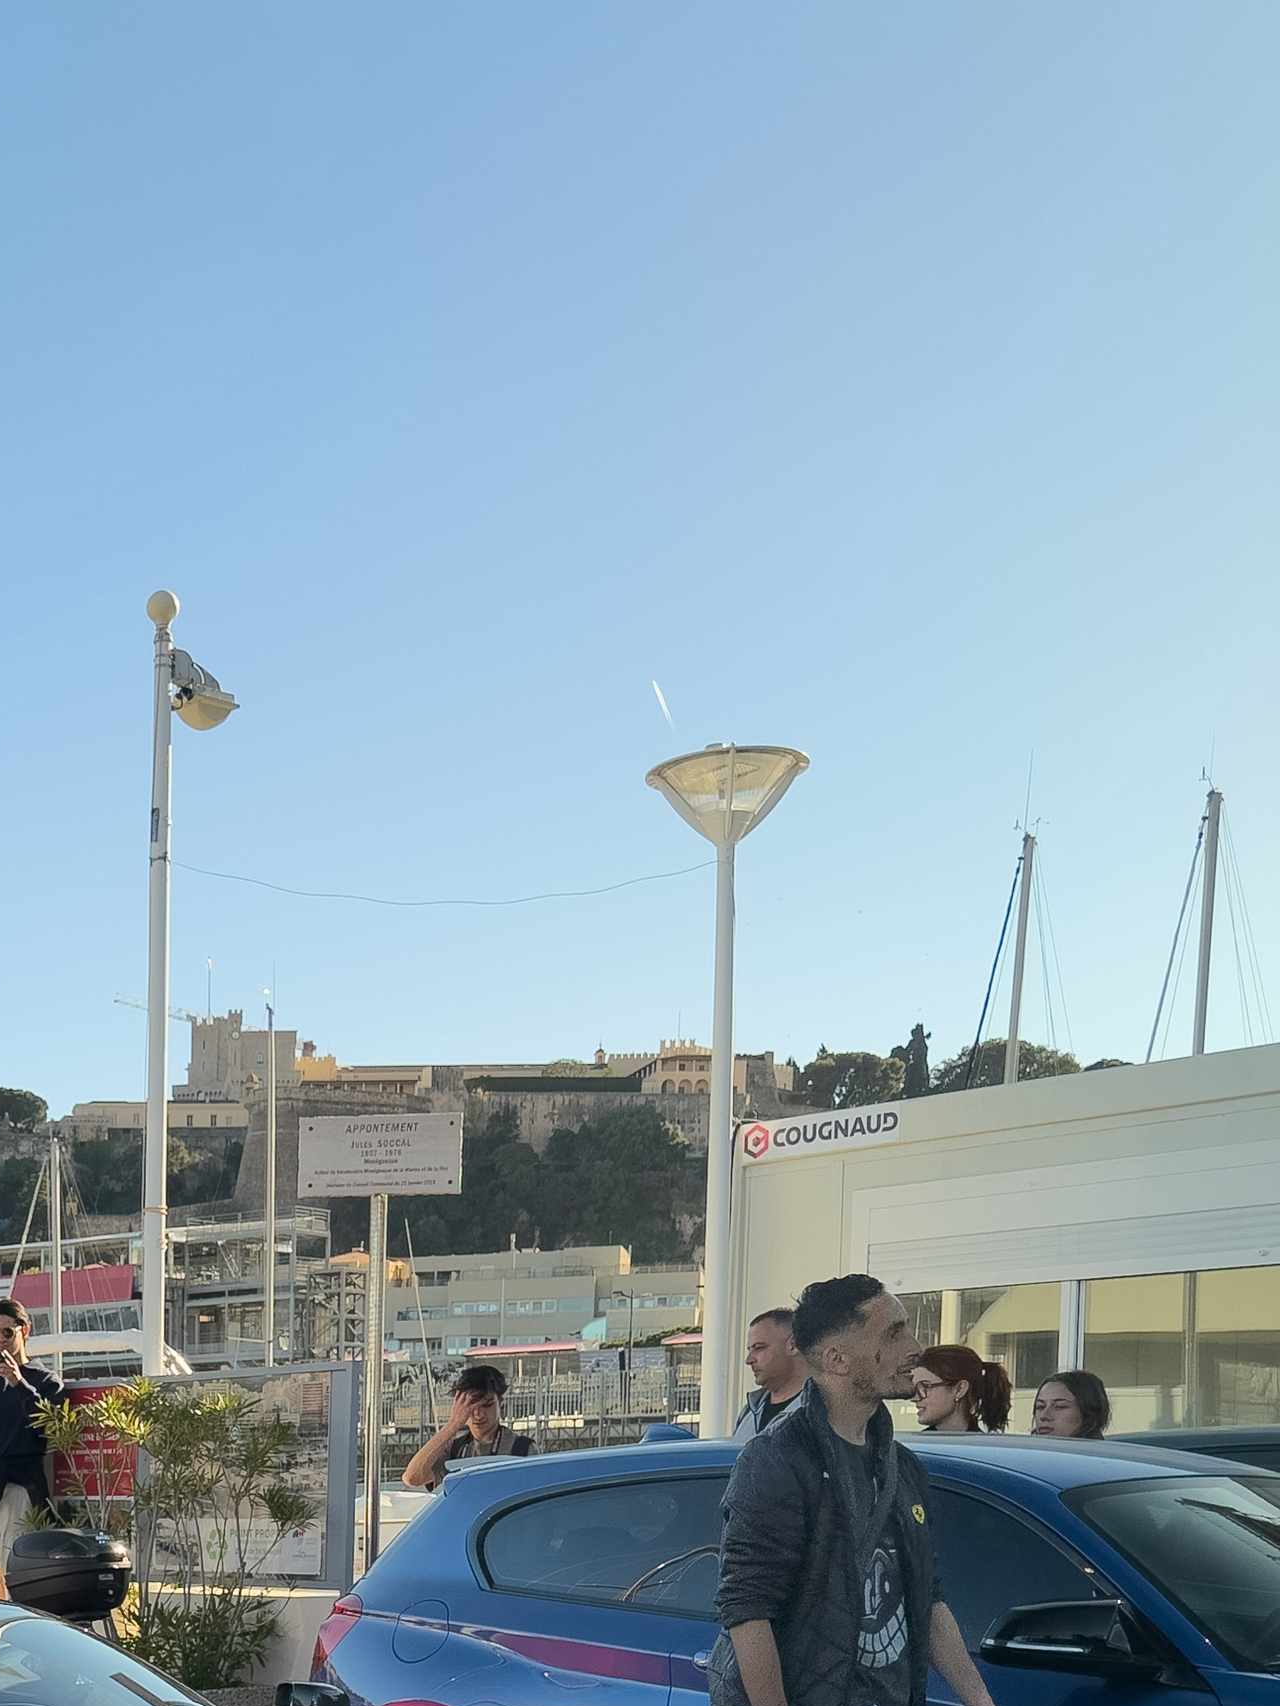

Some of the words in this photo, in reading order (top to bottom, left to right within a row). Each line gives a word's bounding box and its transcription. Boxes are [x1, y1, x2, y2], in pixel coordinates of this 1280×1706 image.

[345, 1122, 419, 1134] APPONTEMENT
[772, 1111, 899, 1147] COUGNAUD
[377, 1139, 412, 1148] SOCCAL
